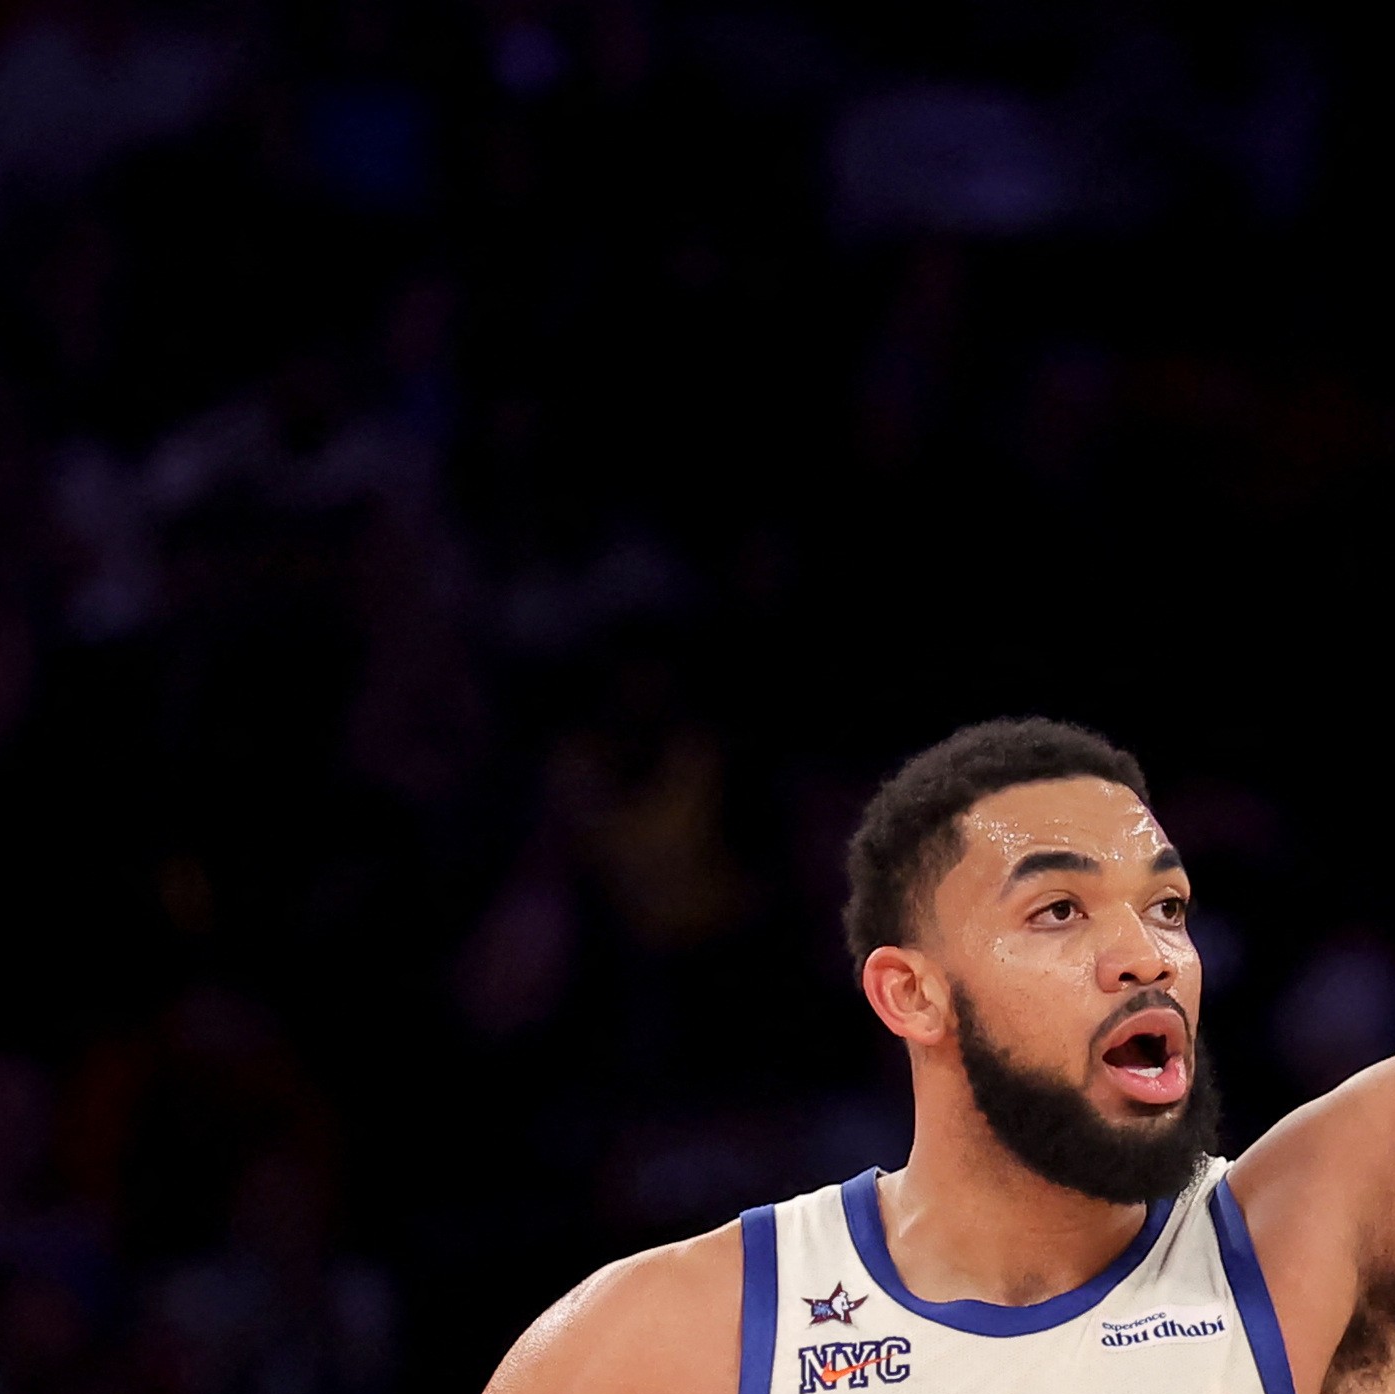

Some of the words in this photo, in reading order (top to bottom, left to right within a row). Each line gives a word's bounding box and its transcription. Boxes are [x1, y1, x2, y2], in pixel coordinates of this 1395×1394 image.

[1102, 1311, 1166, 1332] experience
[1101, 1330, 1149, 1347] abu
[798, 1336, 911, 1394] NYC
